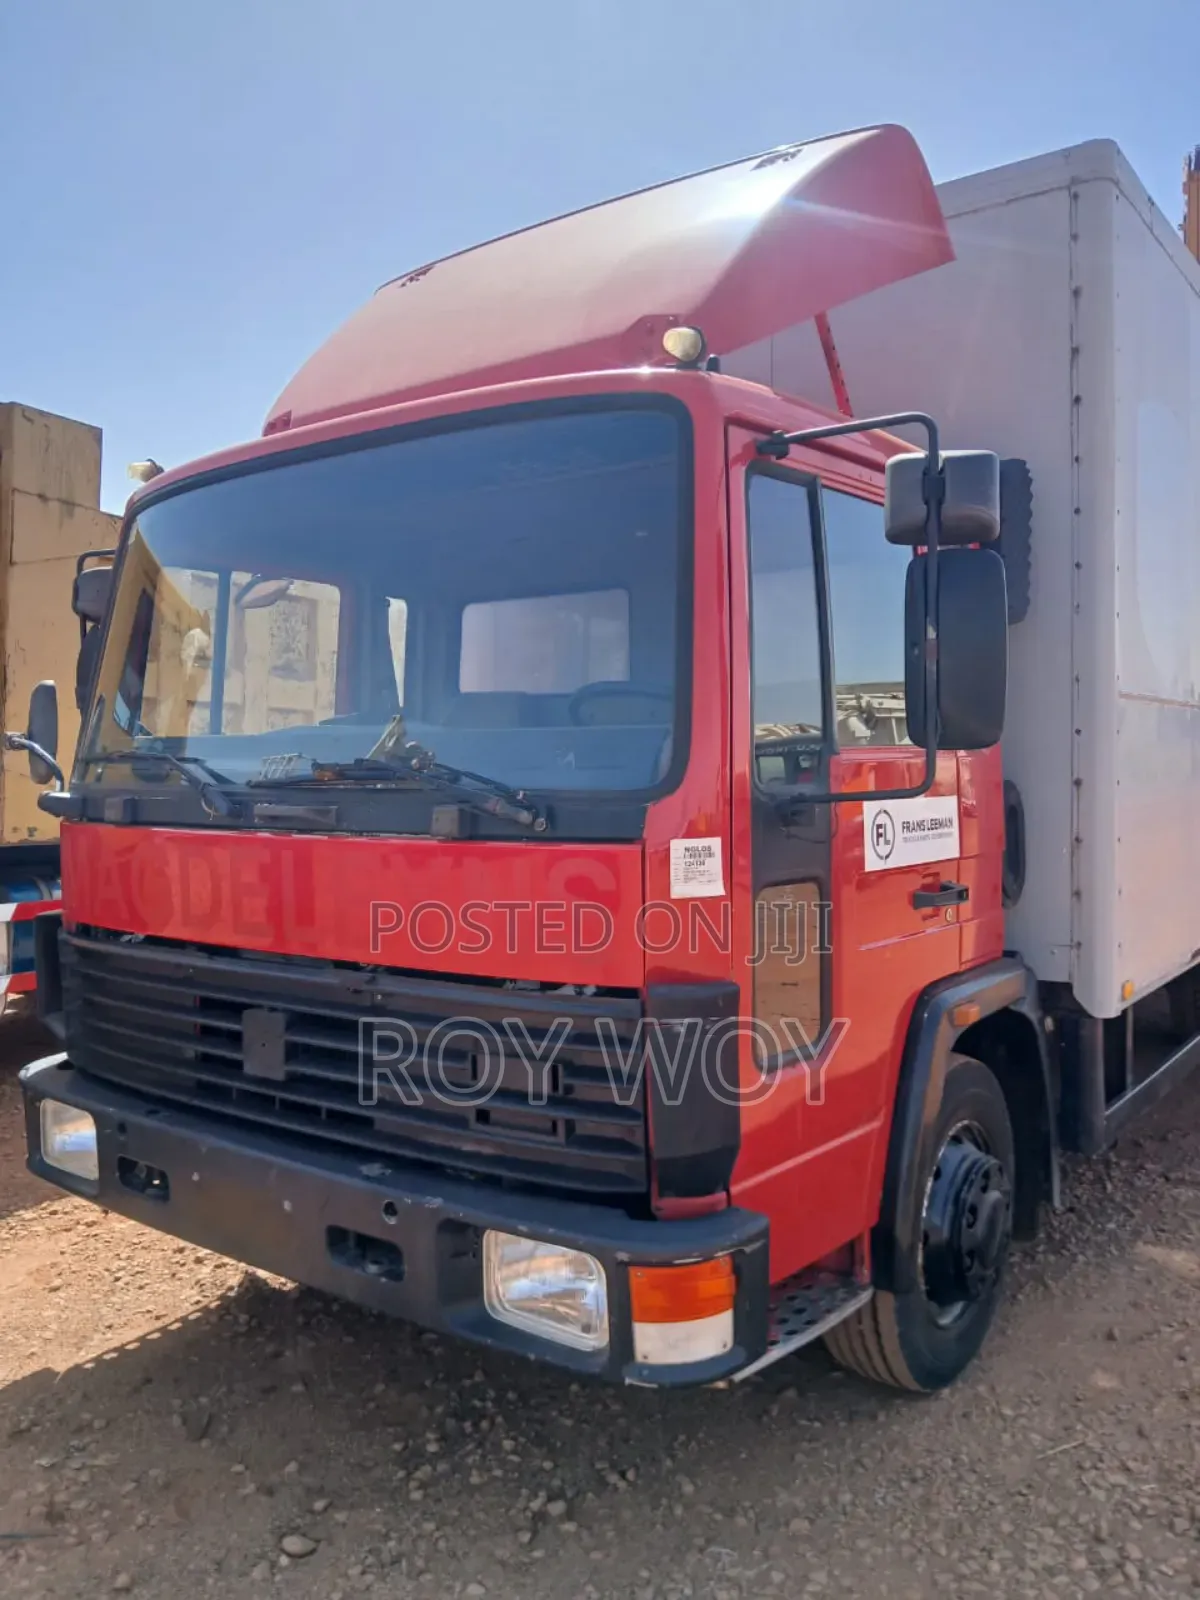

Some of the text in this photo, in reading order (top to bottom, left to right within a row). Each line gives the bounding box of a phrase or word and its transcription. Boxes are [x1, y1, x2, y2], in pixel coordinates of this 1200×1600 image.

[875, 823, 891, 846] FL
[901, 816, 953, 833] FRANS LEEMAN
